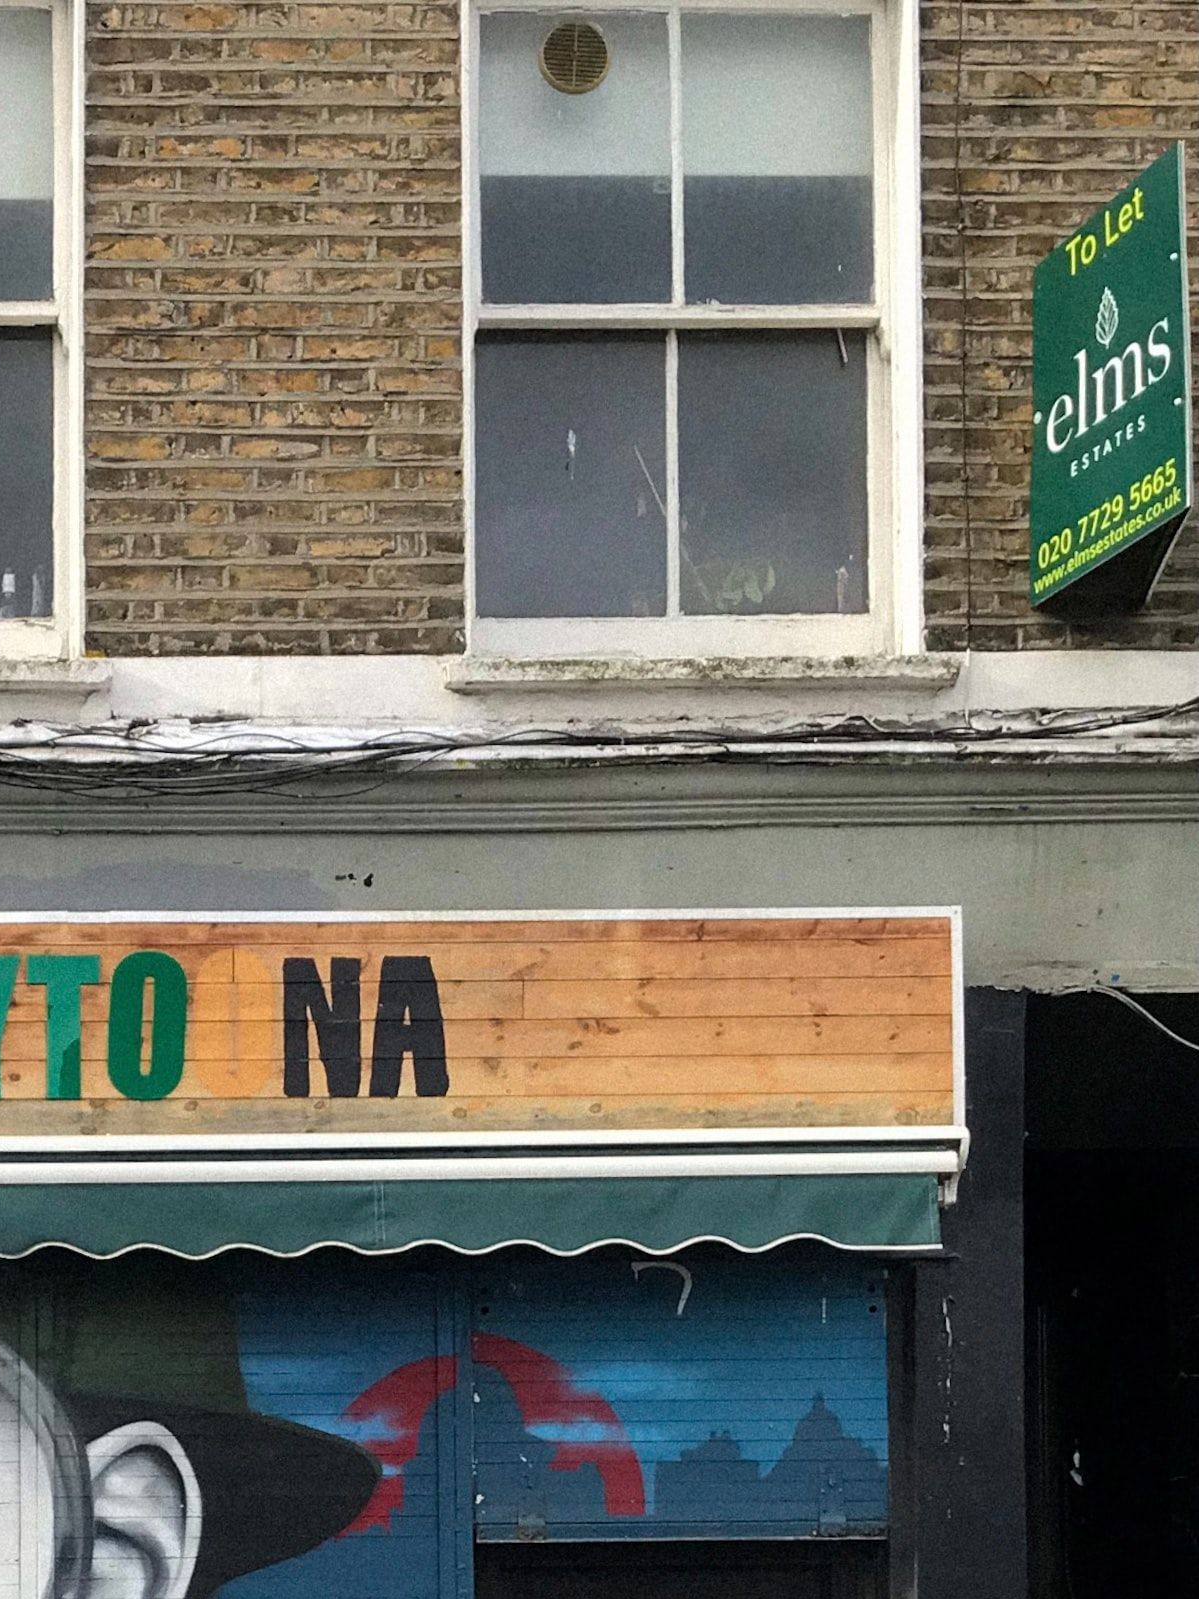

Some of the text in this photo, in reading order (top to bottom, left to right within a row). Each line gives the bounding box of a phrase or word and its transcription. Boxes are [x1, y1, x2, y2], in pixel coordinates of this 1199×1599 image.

[1065, 186, 1145, 277] To Let
[1045, 315, 1173, 455] elms
[1069, 413, 1148, 479] ESTATES
[1033, 485, 1182, 594] www.elmsestates.co.uk
[1037, 457, 1177, 570] 020 7729 5665
